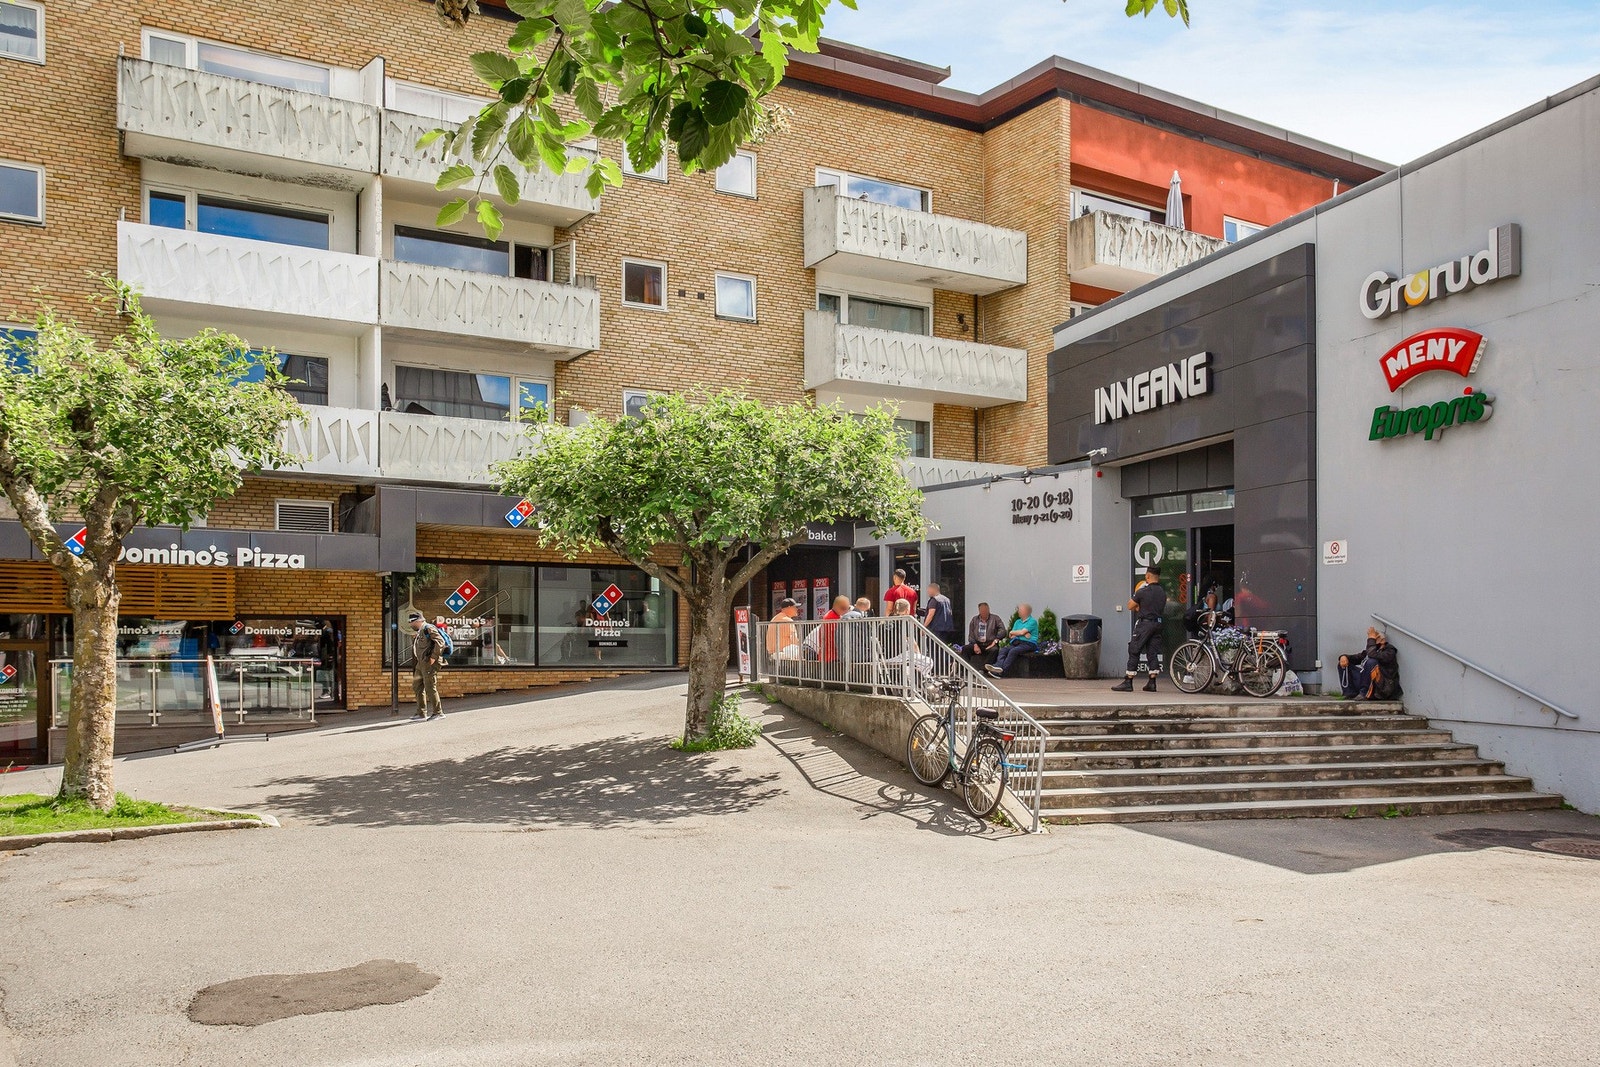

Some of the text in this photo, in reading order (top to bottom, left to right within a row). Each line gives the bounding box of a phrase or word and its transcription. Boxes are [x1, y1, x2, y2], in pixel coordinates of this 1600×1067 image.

[1360, 226, 1502, 319] Grorud
[1386, 338, 1466, 378] MENY
[1094, 351, 1208, 425] INNGANG
[1368, 386, 1488, 441] Europris
[1011, 488, 1073, 511] 10-20 (9-18)
[1012, 514, 1032, 525] Meny
[237, 546, 305, 569] Pizza
[436, 616, 486, 625] Domino's
[585, 618, 630, 627] Domino's
[152, 625, 182, 635] Pizza
[244, 626, 323, 636] Domino's Pizza
[594, 628, 621, 637] Pizza
